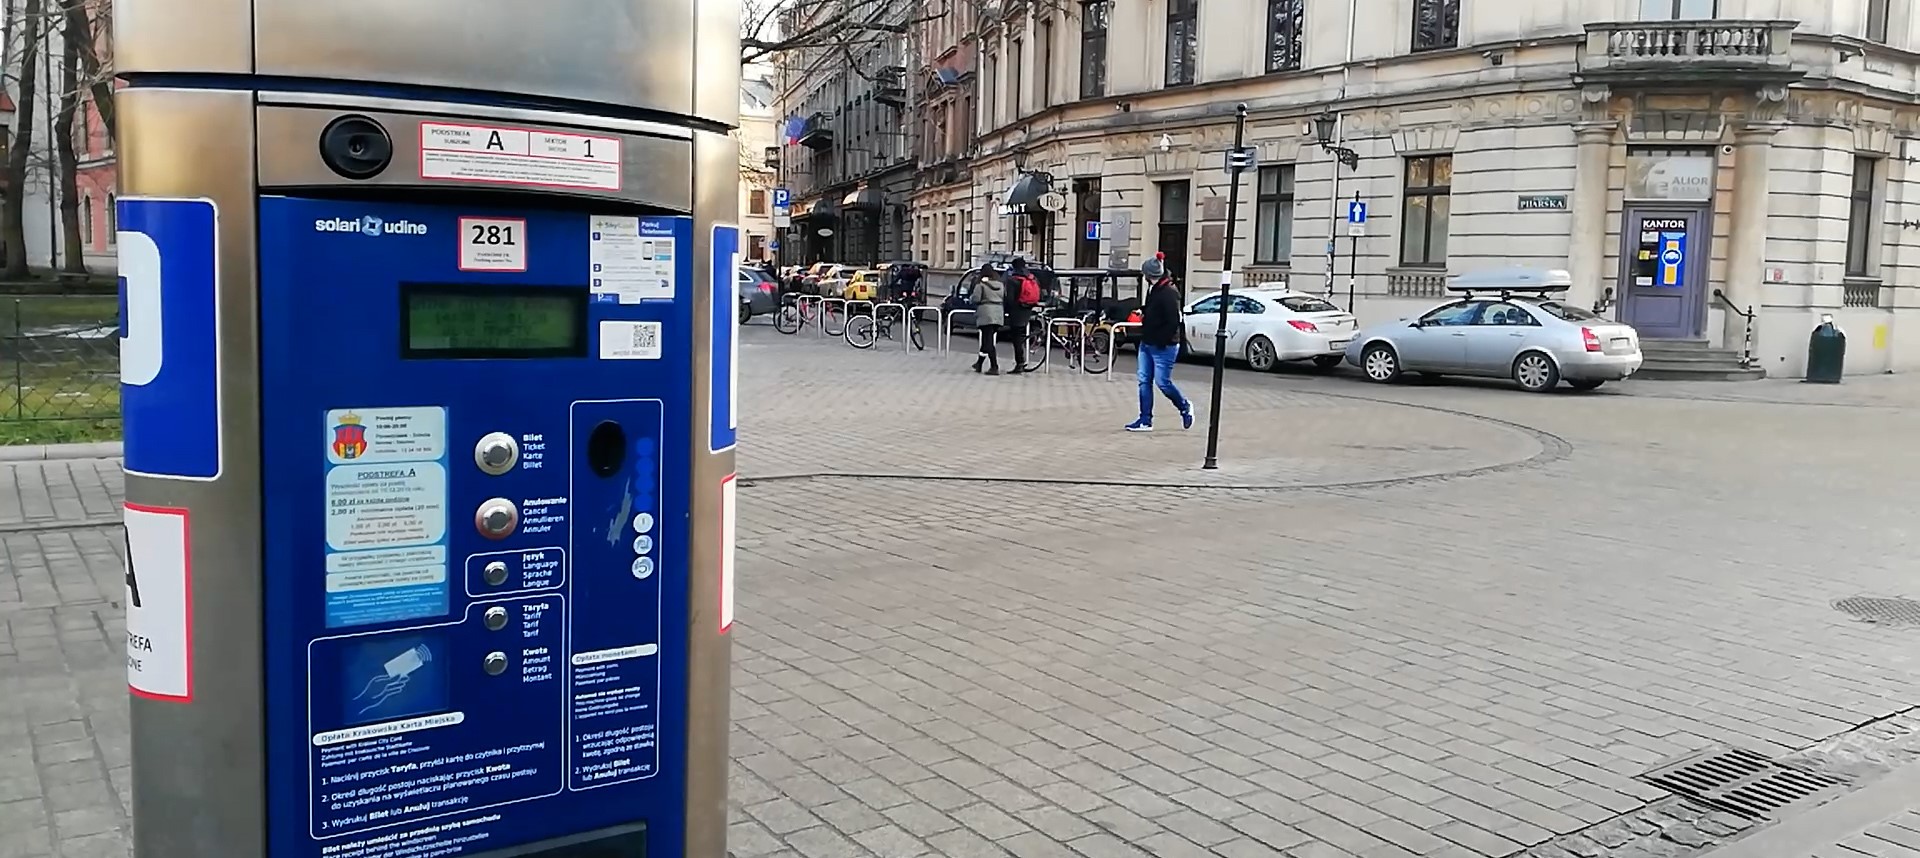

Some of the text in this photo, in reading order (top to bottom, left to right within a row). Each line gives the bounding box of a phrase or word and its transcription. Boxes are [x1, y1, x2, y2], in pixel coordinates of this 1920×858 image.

[486, 130, 504, 151] A
[584, 139, 594, 158] 1
[1672, 176, 1708, 186] ALIOR
[776, 190, 788, 205] P
[316, 218, 428, 235] solari udine
[1643, 220, 1685, 230] KANTOR
[472, 224, 516, 246] 281
[522, 434, 543, 442] Bilet
[522, 452, 543, 460] Karte
[408, 468, 416, 477] A
[522, 507, 548, 516] Cancel
[522, 560, 558, 570] Language
[522, 570, 552, 580] Sprache
[522, 580, 550, 588] Langue
[522, 603, 550, 613] Taryfa
[522, 620, 538, 628] Tarif
[522, 629, 538, 638] Tarif
[522, 647, 548, 656] Kwota
[522, 656, 550, 666] Amount
[522, 666, 548, 674] Betrag
[522, 674, 552, 683] Montant
[322, 778, 329, 786] 1.
[360, 768, 390, 780] przycisk
[446, 755, 464, 764] kartę
[388, 780, 416, 791] postoju
[456, 767, 484, 780] przycisk
[486, 764, 510, 773] Kwota
[343, 796, 380, 808] uzyskania
[442, 776, 489, 791] planowanego
[490, 773, 510, 781] czasu
[512, 768, 538, 778] postoju
[322, 822, 330, 830] 3.
[331, 814, 368, 828] Wydrukuj
[369, 810, 389, 820] Bilet
[390, 808, 402, 816] lub
[404, 802, 430, 814] Anuluj
[322, 846, 340, 854] Bilet
